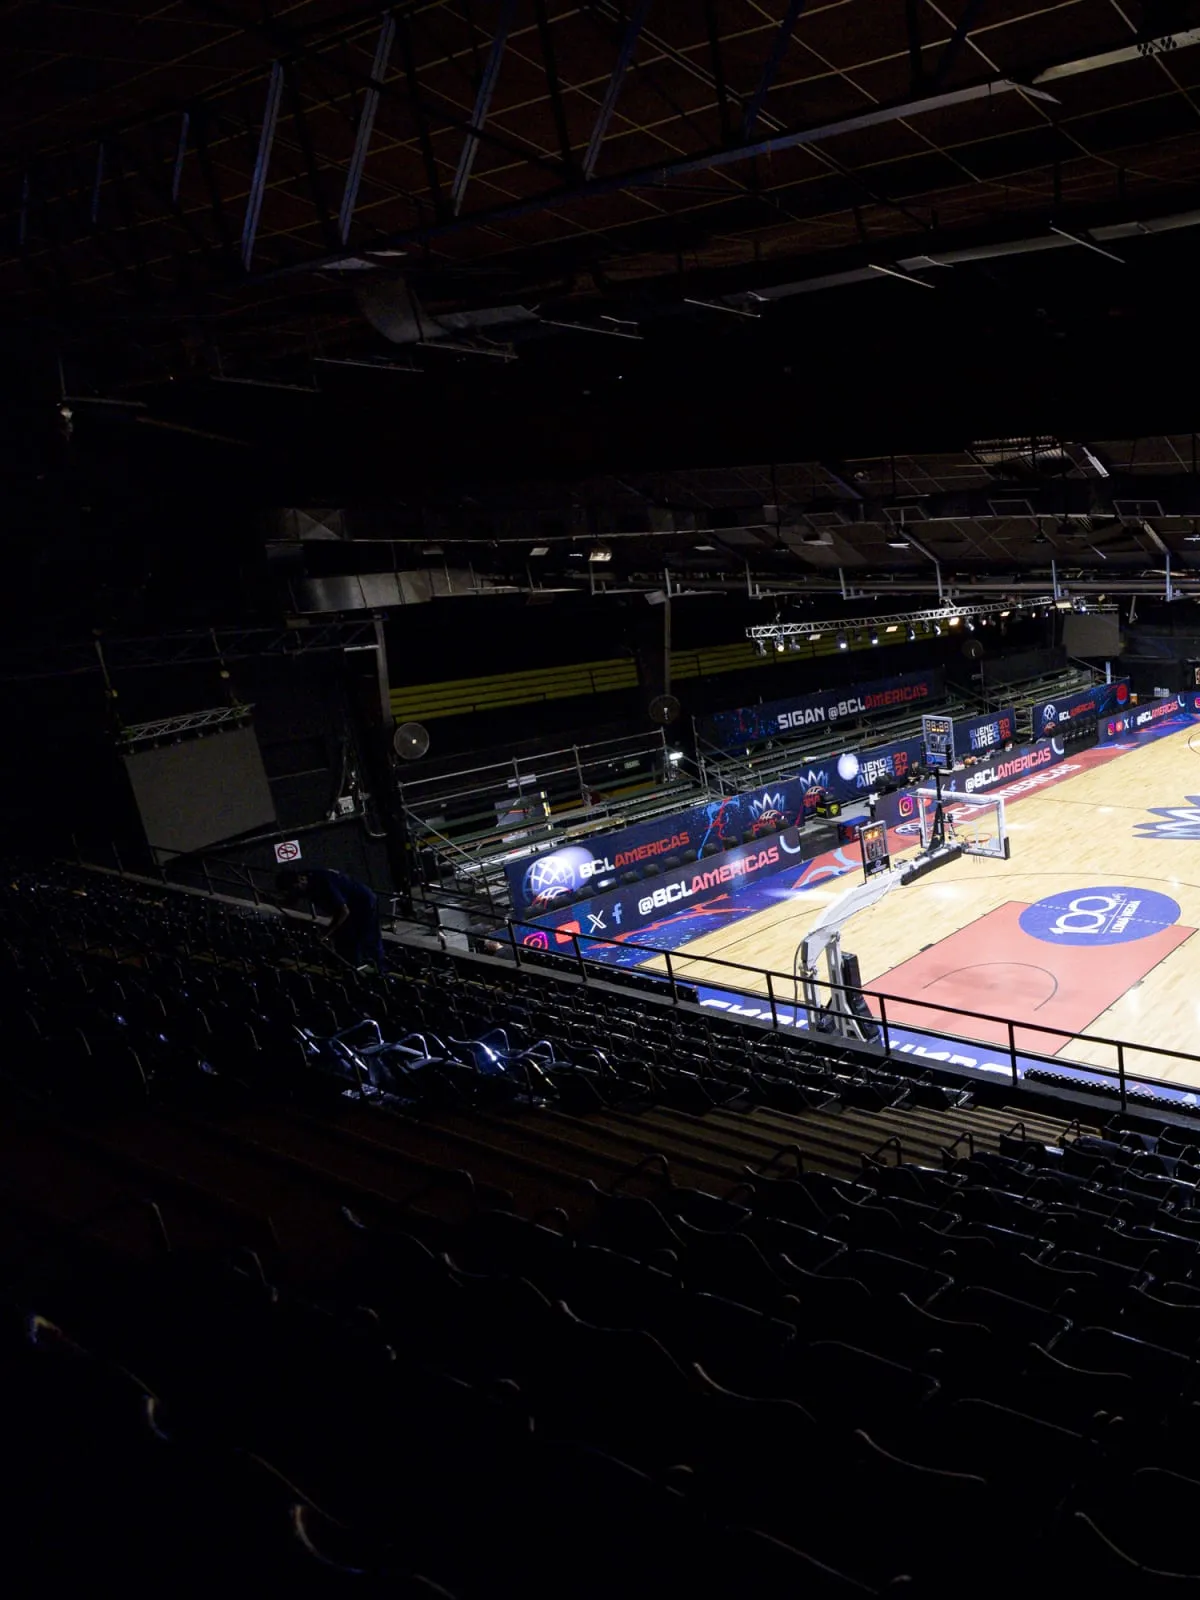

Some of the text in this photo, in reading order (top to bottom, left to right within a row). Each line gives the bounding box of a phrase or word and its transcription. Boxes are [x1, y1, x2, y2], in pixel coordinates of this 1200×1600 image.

[777, 682, 928, 730] SIGAN @BCLAMERICAS
[969, 718, 1009, 738] BUENOS 20
[859, 751, 908, 774] UENOS 20
[971, 730, 1000, 750] AIRES
[965, 747, 1051, 793] @BCLAMERICAS
[579, 831, 690, 879] BCLAMERICAS
[638, 845, 780, 915] @BCLAMERICAS
